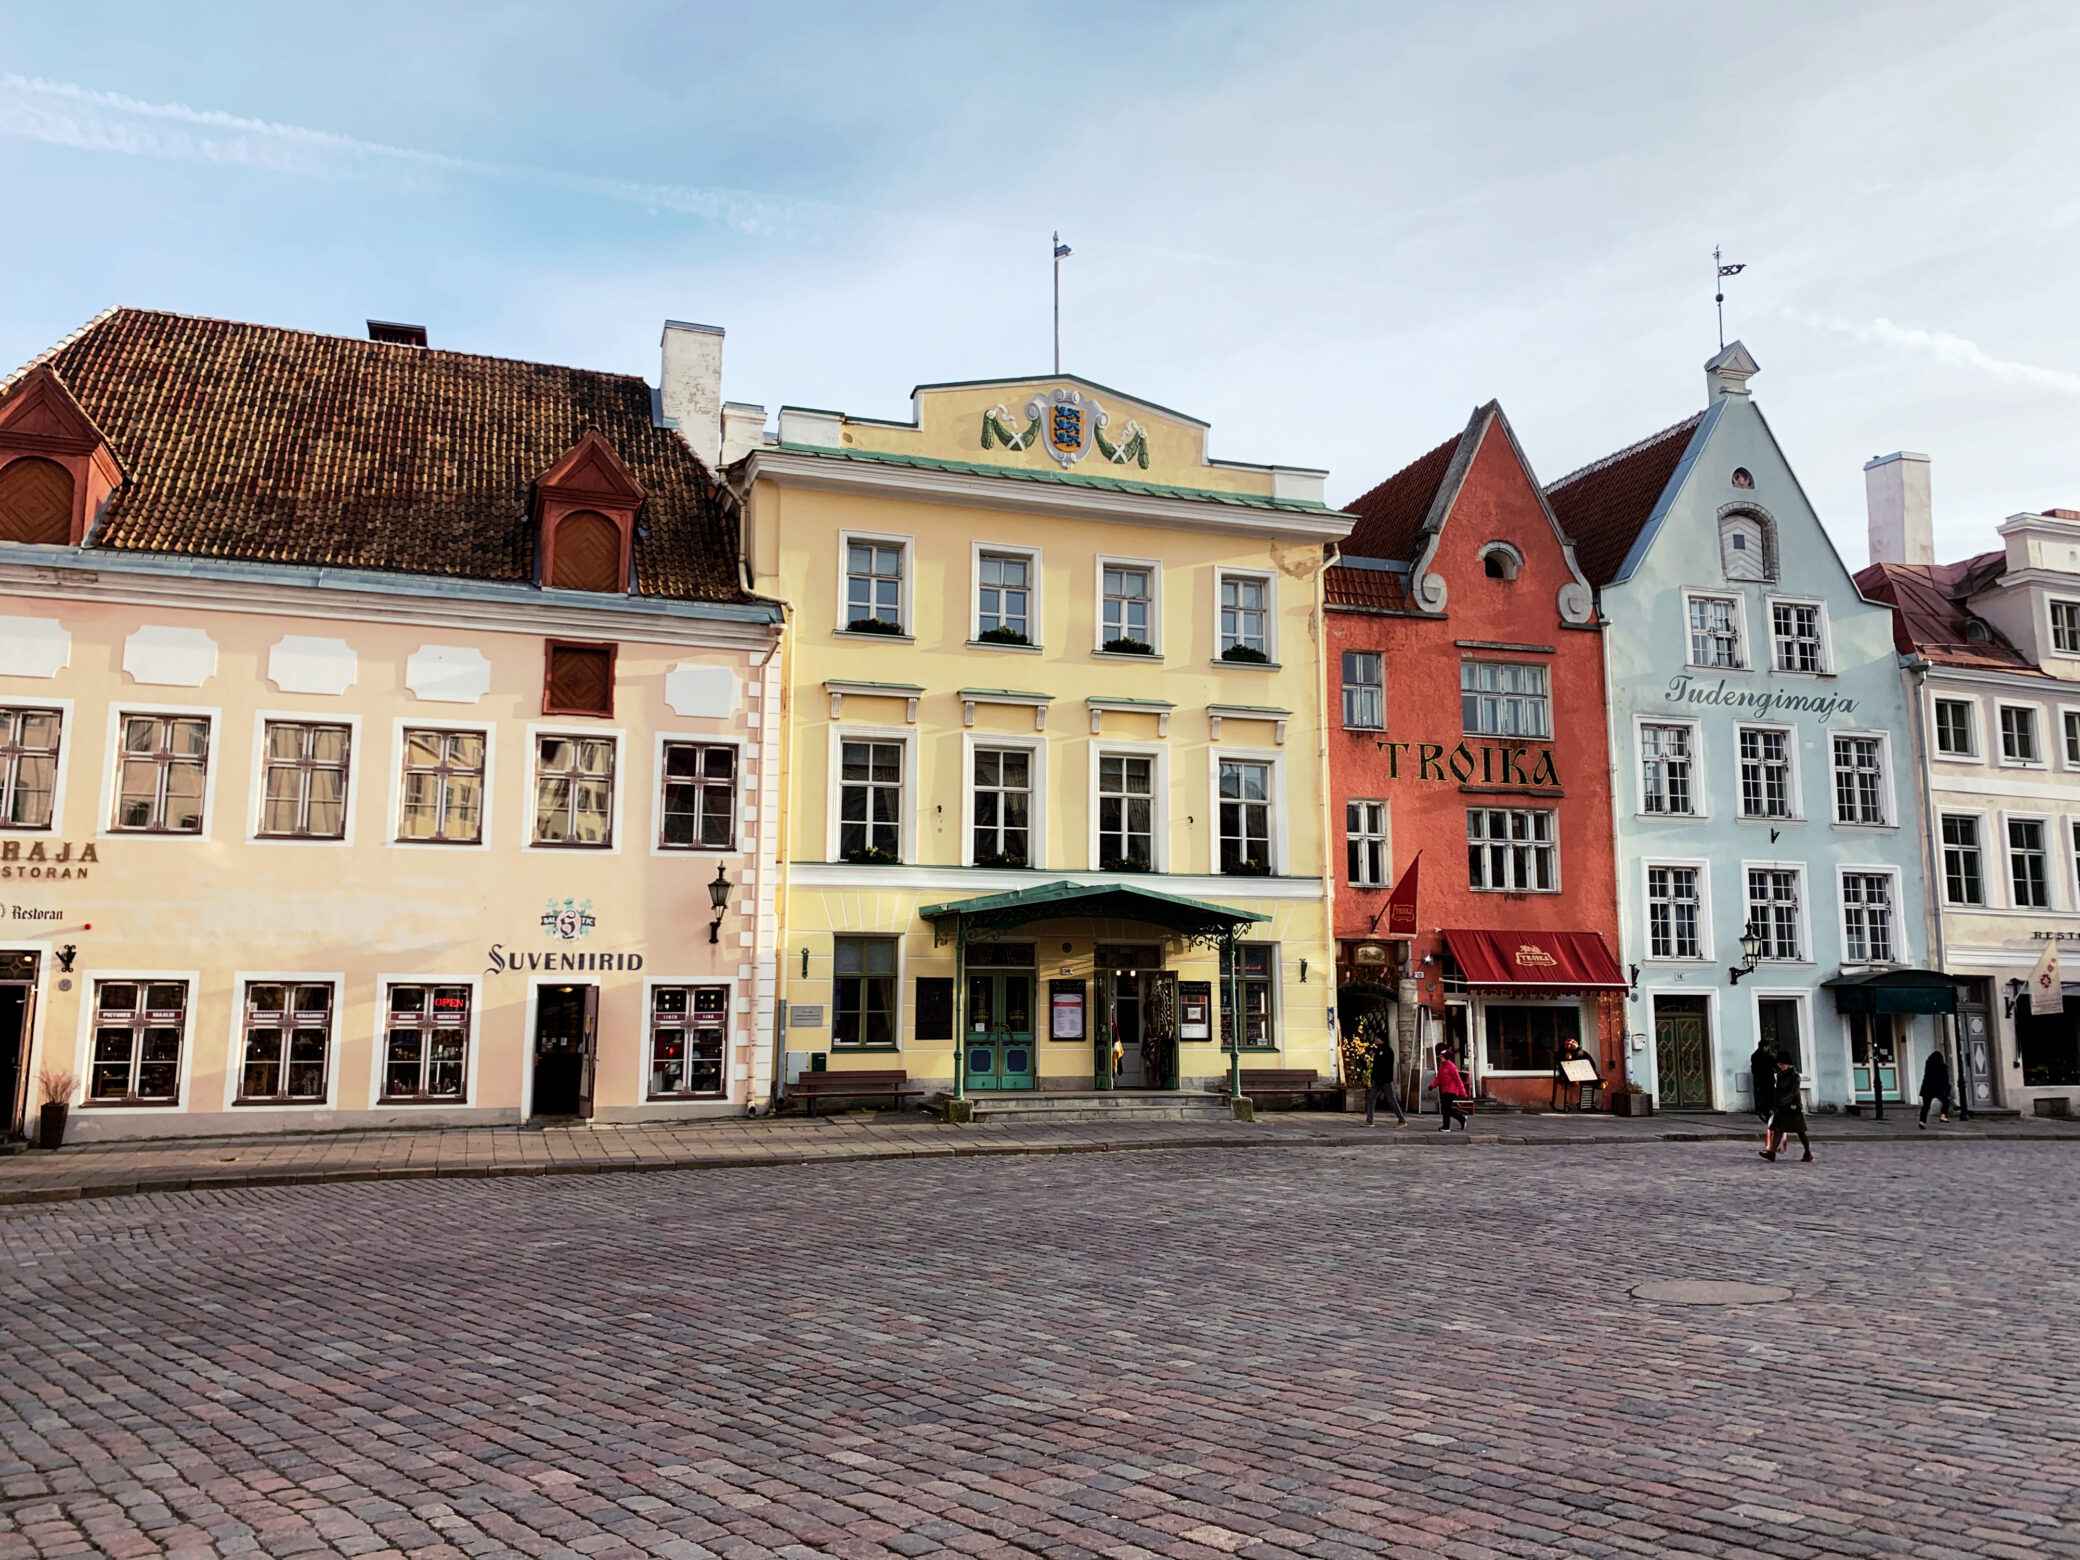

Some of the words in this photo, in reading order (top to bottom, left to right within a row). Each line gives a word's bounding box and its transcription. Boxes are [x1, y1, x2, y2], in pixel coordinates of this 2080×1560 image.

[1664, 674, 1861, 724] Tudengimaja
[1376, 739, 1563, 787] TROIKA
[12, 905, 63, 920] Restoran
[543, 916, 556, 924] BAL
[581, 917, 594, 925] TIC
[434, 998, 464, 1008] OPEN
